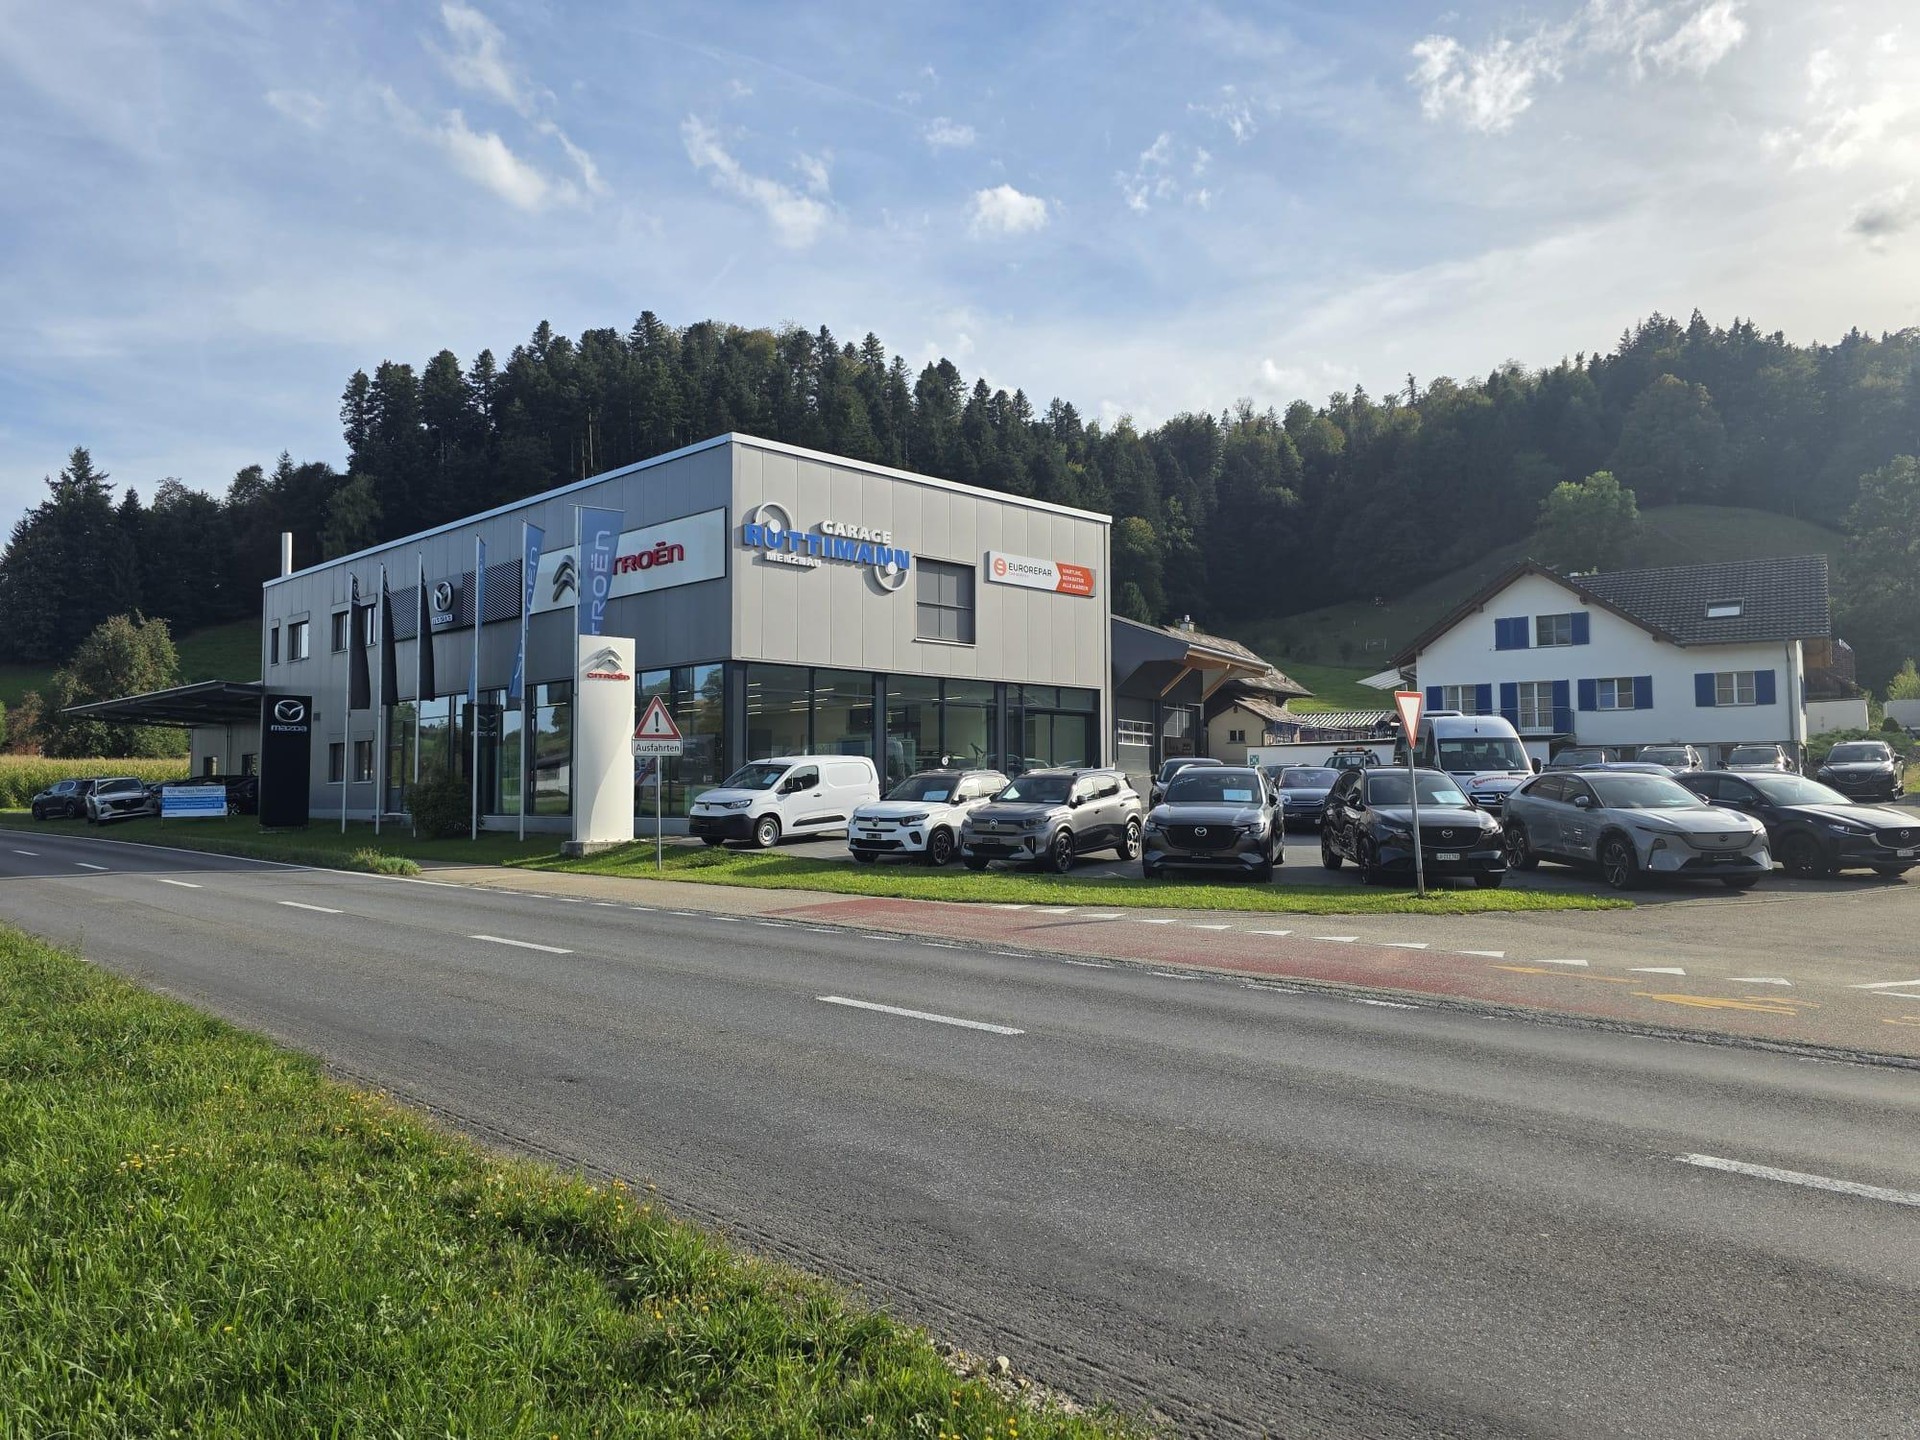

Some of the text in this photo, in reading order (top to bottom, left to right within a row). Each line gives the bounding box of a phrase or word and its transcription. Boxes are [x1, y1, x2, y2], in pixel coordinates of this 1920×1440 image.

[820, 520, 892, 544] GARAGE
[1008, 562, 1052, 577] EUROREPAR
[635, 743, 680, 753] Ausfahrten
